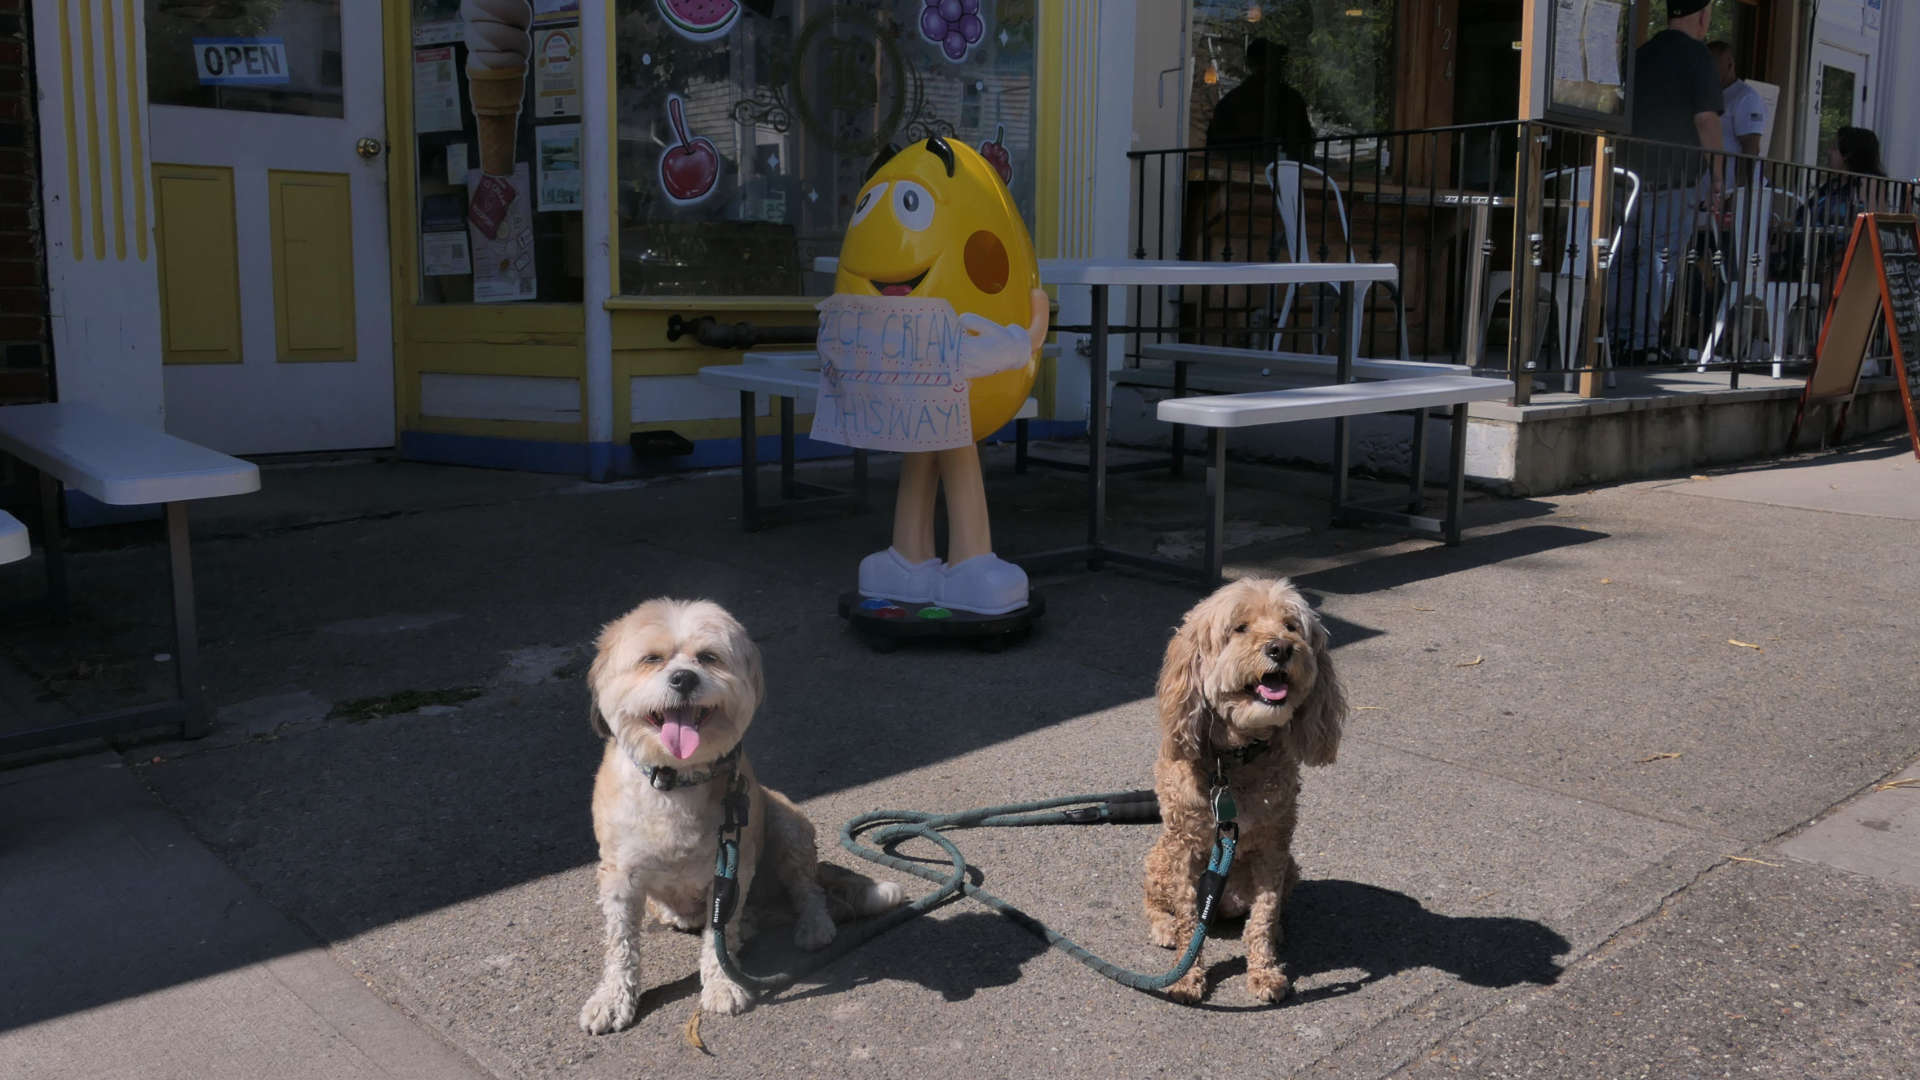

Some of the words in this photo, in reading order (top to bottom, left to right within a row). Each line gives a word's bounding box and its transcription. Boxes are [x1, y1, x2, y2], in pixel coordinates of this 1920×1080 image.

[204, 46, 281, 76] OPEN
[819, 310, 873, 349] ICE
[881, 313, 963, 368] CREAM
